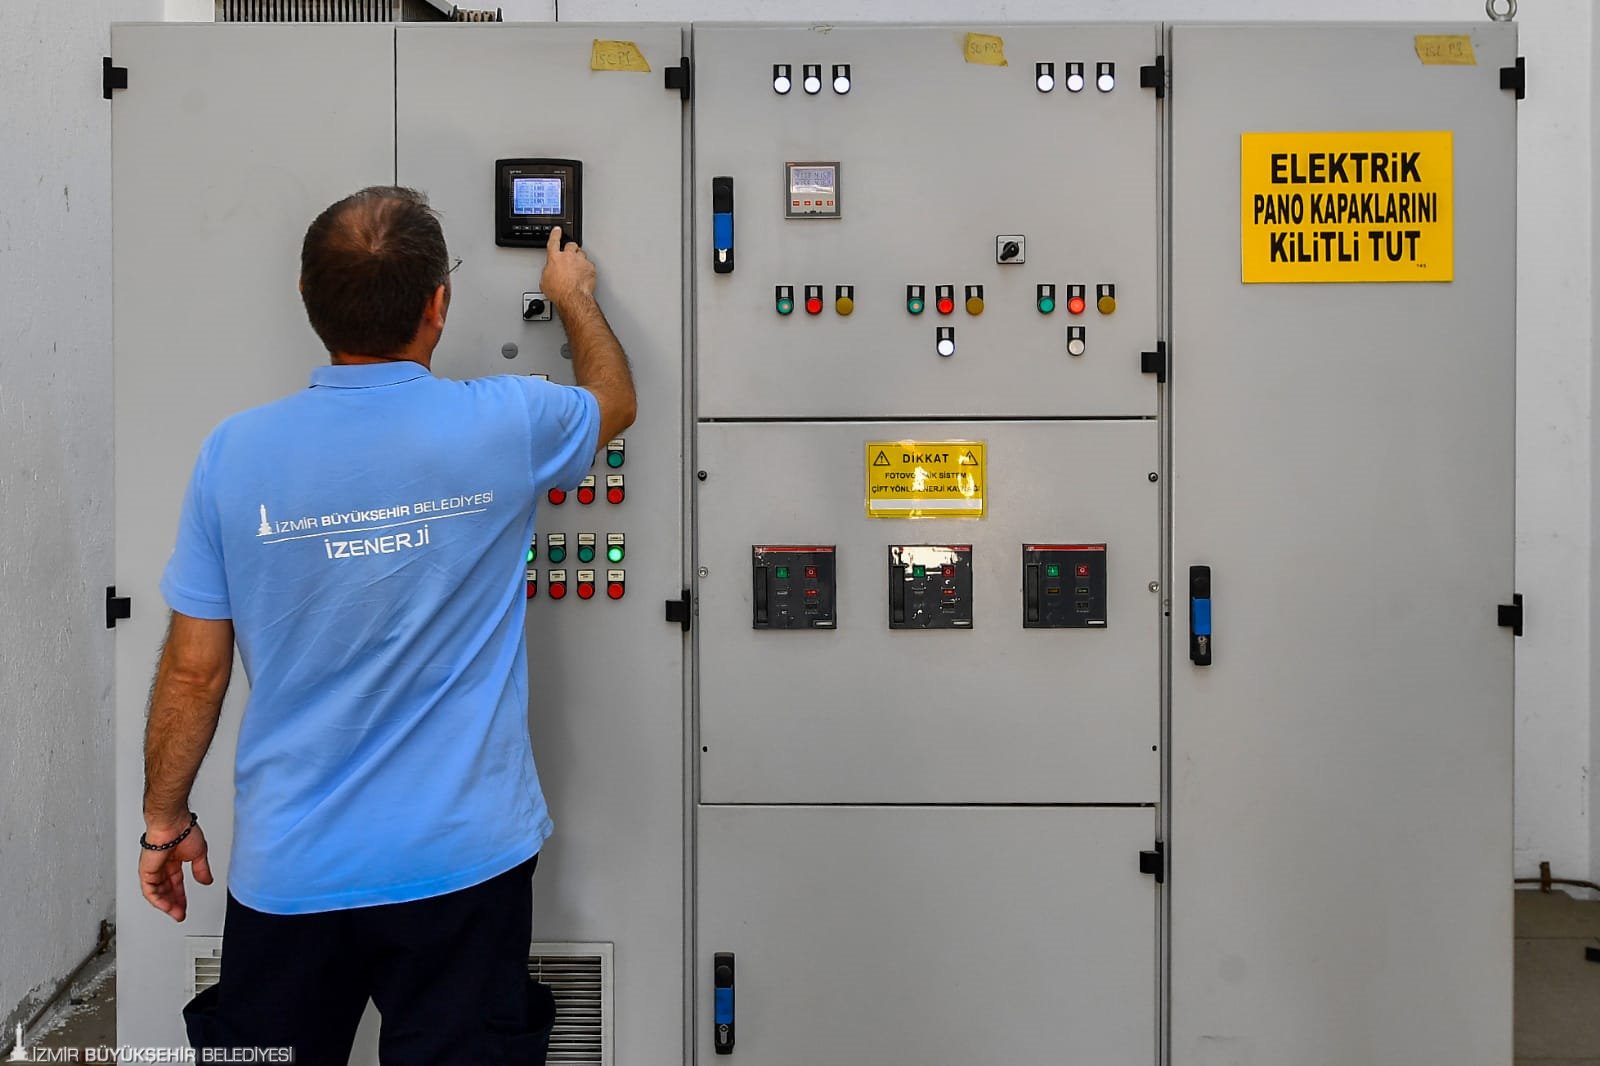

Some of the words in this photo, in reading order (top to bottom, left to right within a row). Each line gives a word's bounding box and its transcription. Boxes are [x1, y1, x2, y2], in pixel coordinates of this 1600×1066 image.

[1253, 193, 1304, 225] PANO
[1310, 191, 1438, 225] KAPAKLARINI
[1367, 230, 1421, 262] TUT
[902, 452, 949, 464] DİKKAT
[275, 516, 318, 534] İZMİR
[321, 504, 411, 528] BÜYÜKŞEHİR
[414, 489, 494, 514] BELEDİYESİ
[324, 524, 430, 560] İZENERJİ
